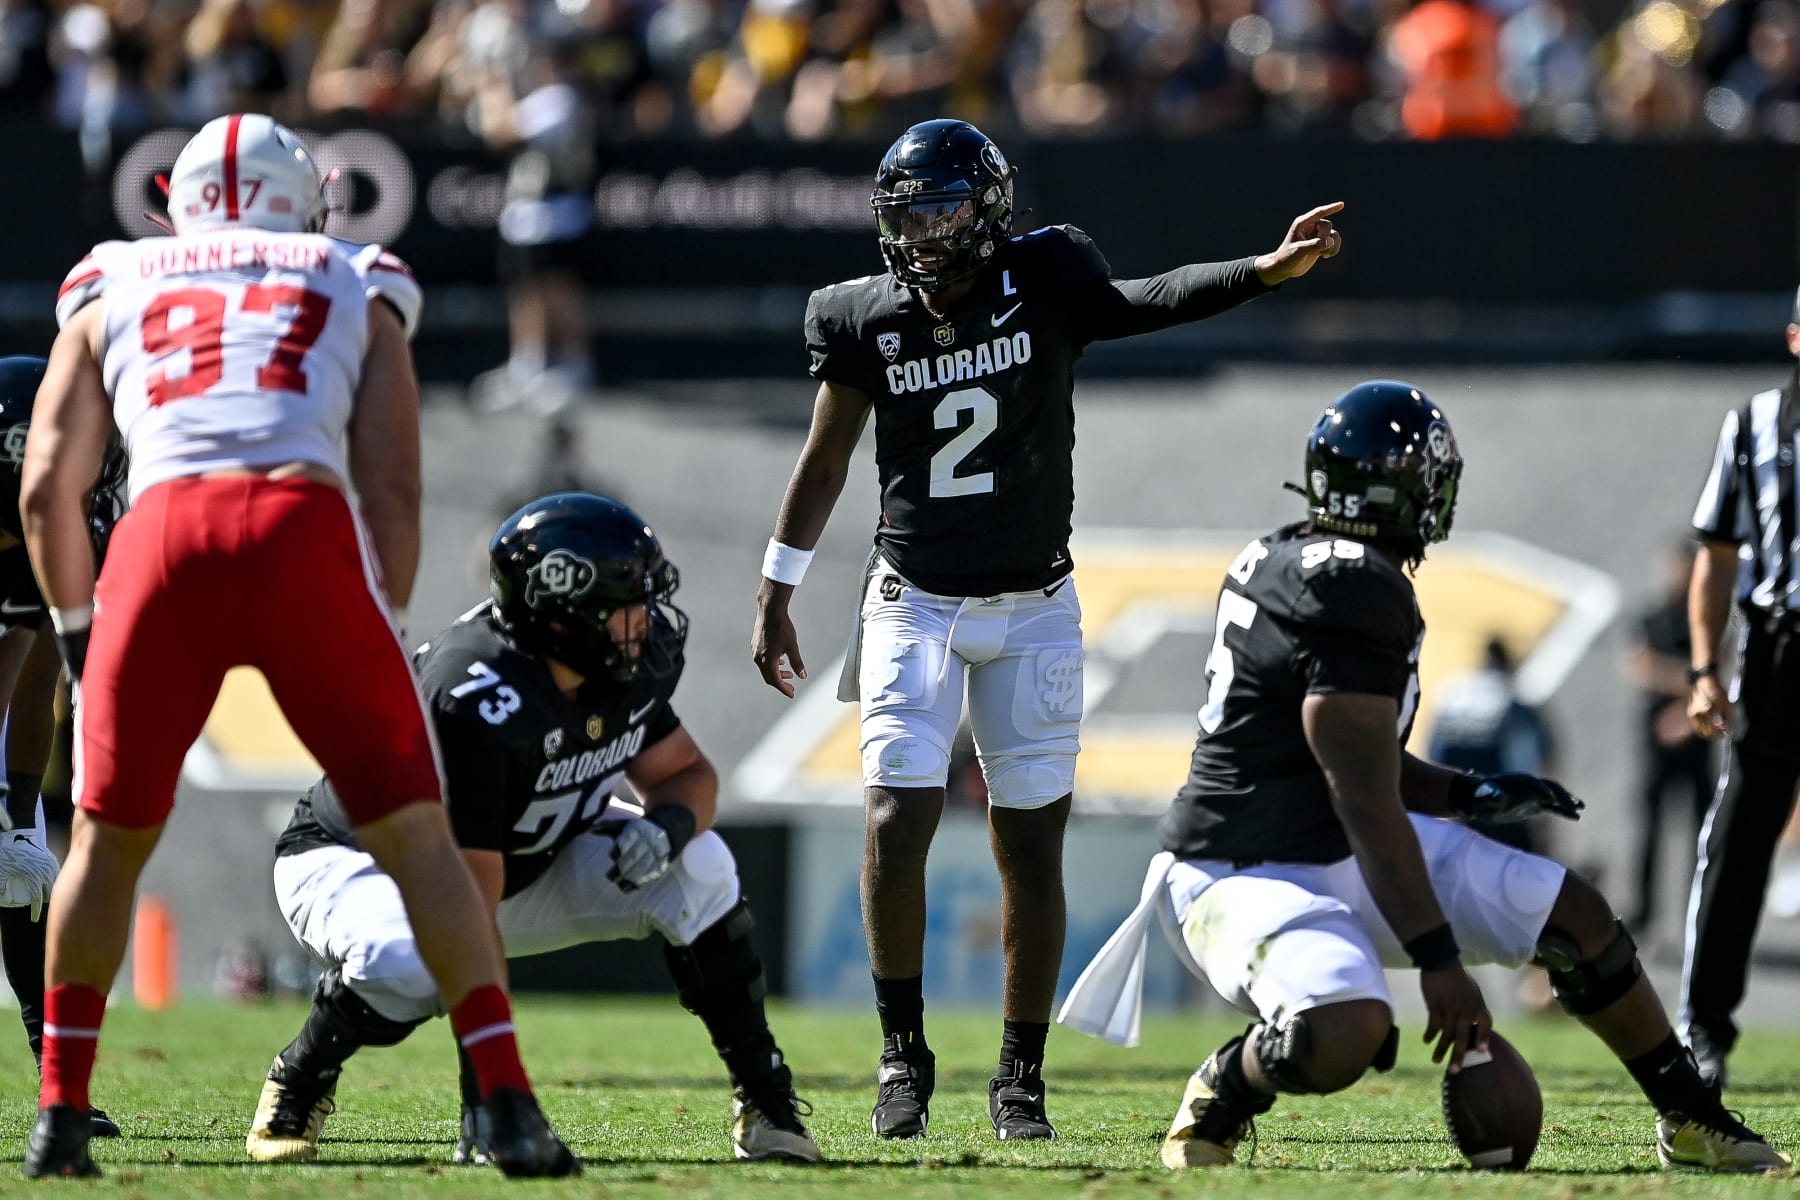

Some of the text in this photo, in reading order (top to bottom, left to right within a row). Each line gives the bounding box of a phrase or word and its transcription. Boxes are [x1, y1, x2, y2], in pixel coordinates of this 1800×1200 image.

[903, 181, 923, 193] S2S
[139, 240, 333, 280] GUNNERSON
[1002, 269, 1017, 296] L
[141, 284, 333, 408] 97
[885, 331, 1032, 395] COLORADO
[929, 386, 998, 498] 2
[1328, 491, 1361, 518] 55
[450, 660, 522, 725] 73
[535, 724, 647, 792] COLORADO
